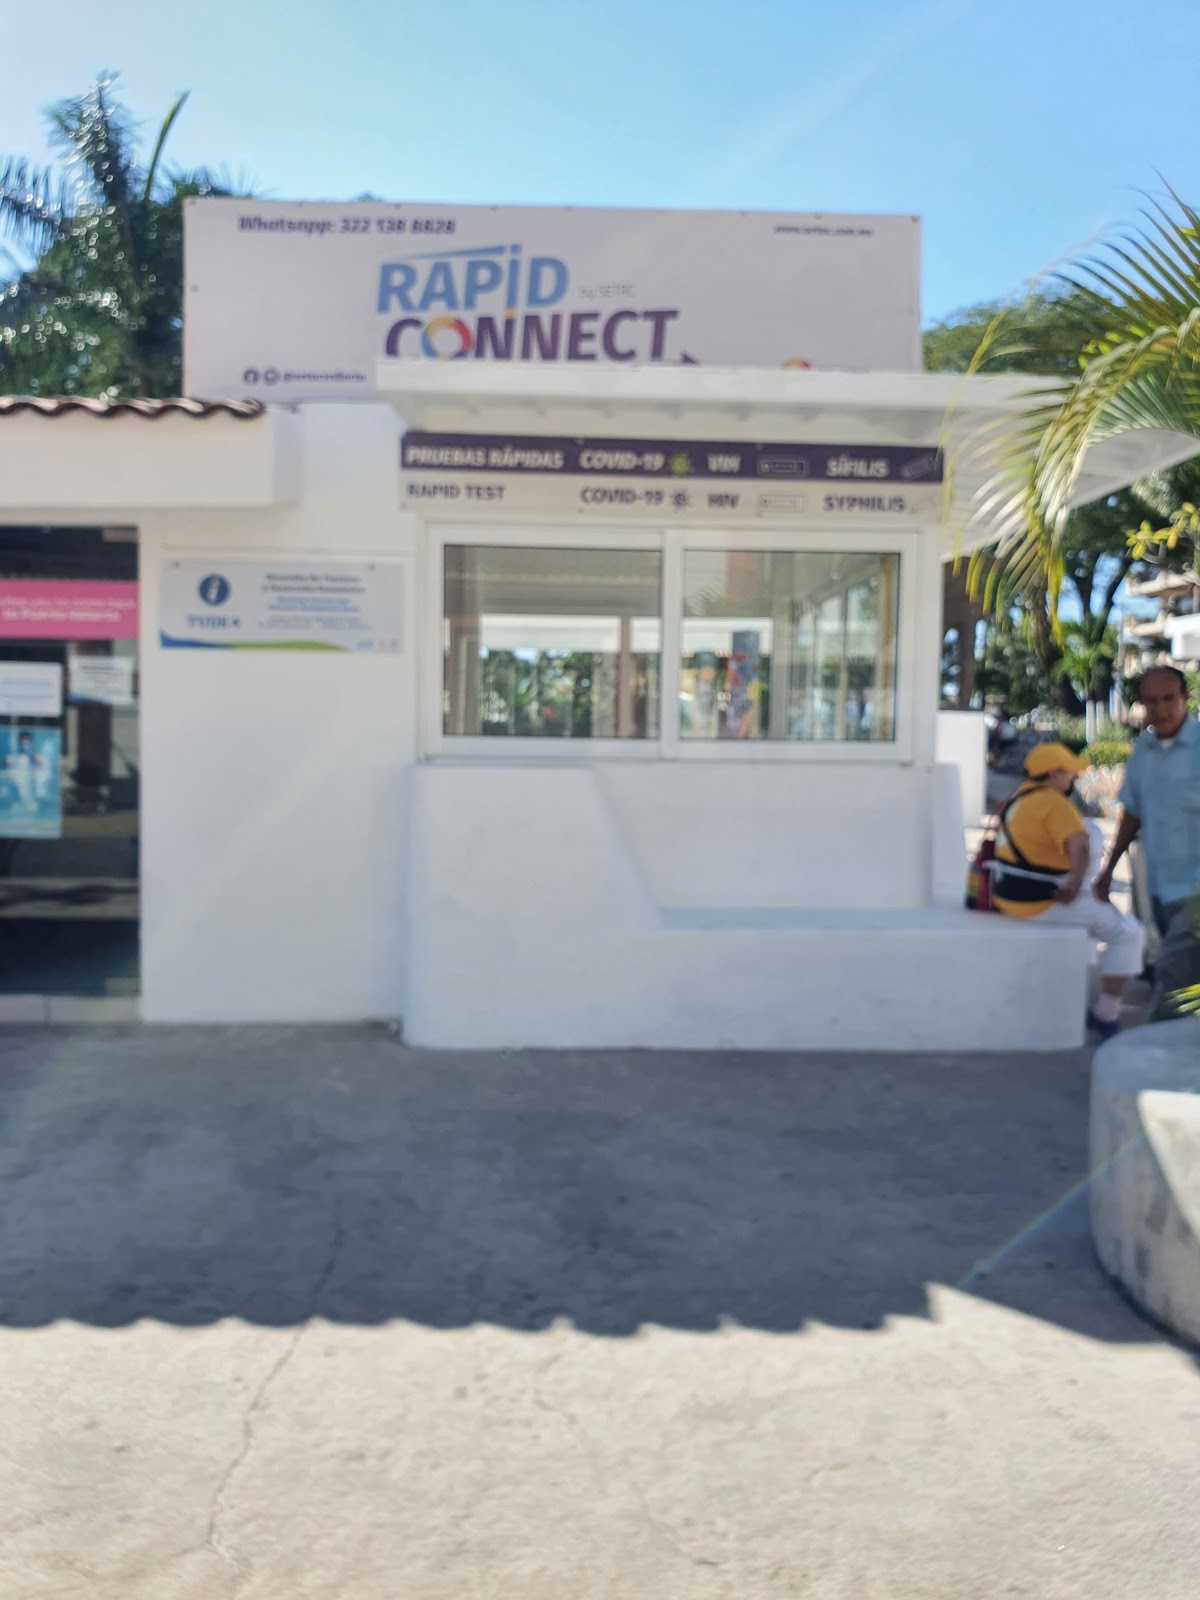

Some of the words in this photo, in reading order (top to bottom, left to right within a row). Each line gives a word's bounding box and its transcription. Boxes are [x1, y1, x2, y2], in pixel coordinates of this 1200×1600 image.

[385, 310, 680, 361] CONNECT
[406, 446, 487, 468] PRUEBAS
[488, 445, 565, 470] RÁPIDAS
[578, 449, 666, 472] COVID-19
[706, 453, 742, 474] VIH
[407, 483, 461, 500] RAPID
[465, 484, 506, 501] TEST
[580, 487, 665, 506] COVID-19
[823, 494, 906, 513] SYPHILIS
